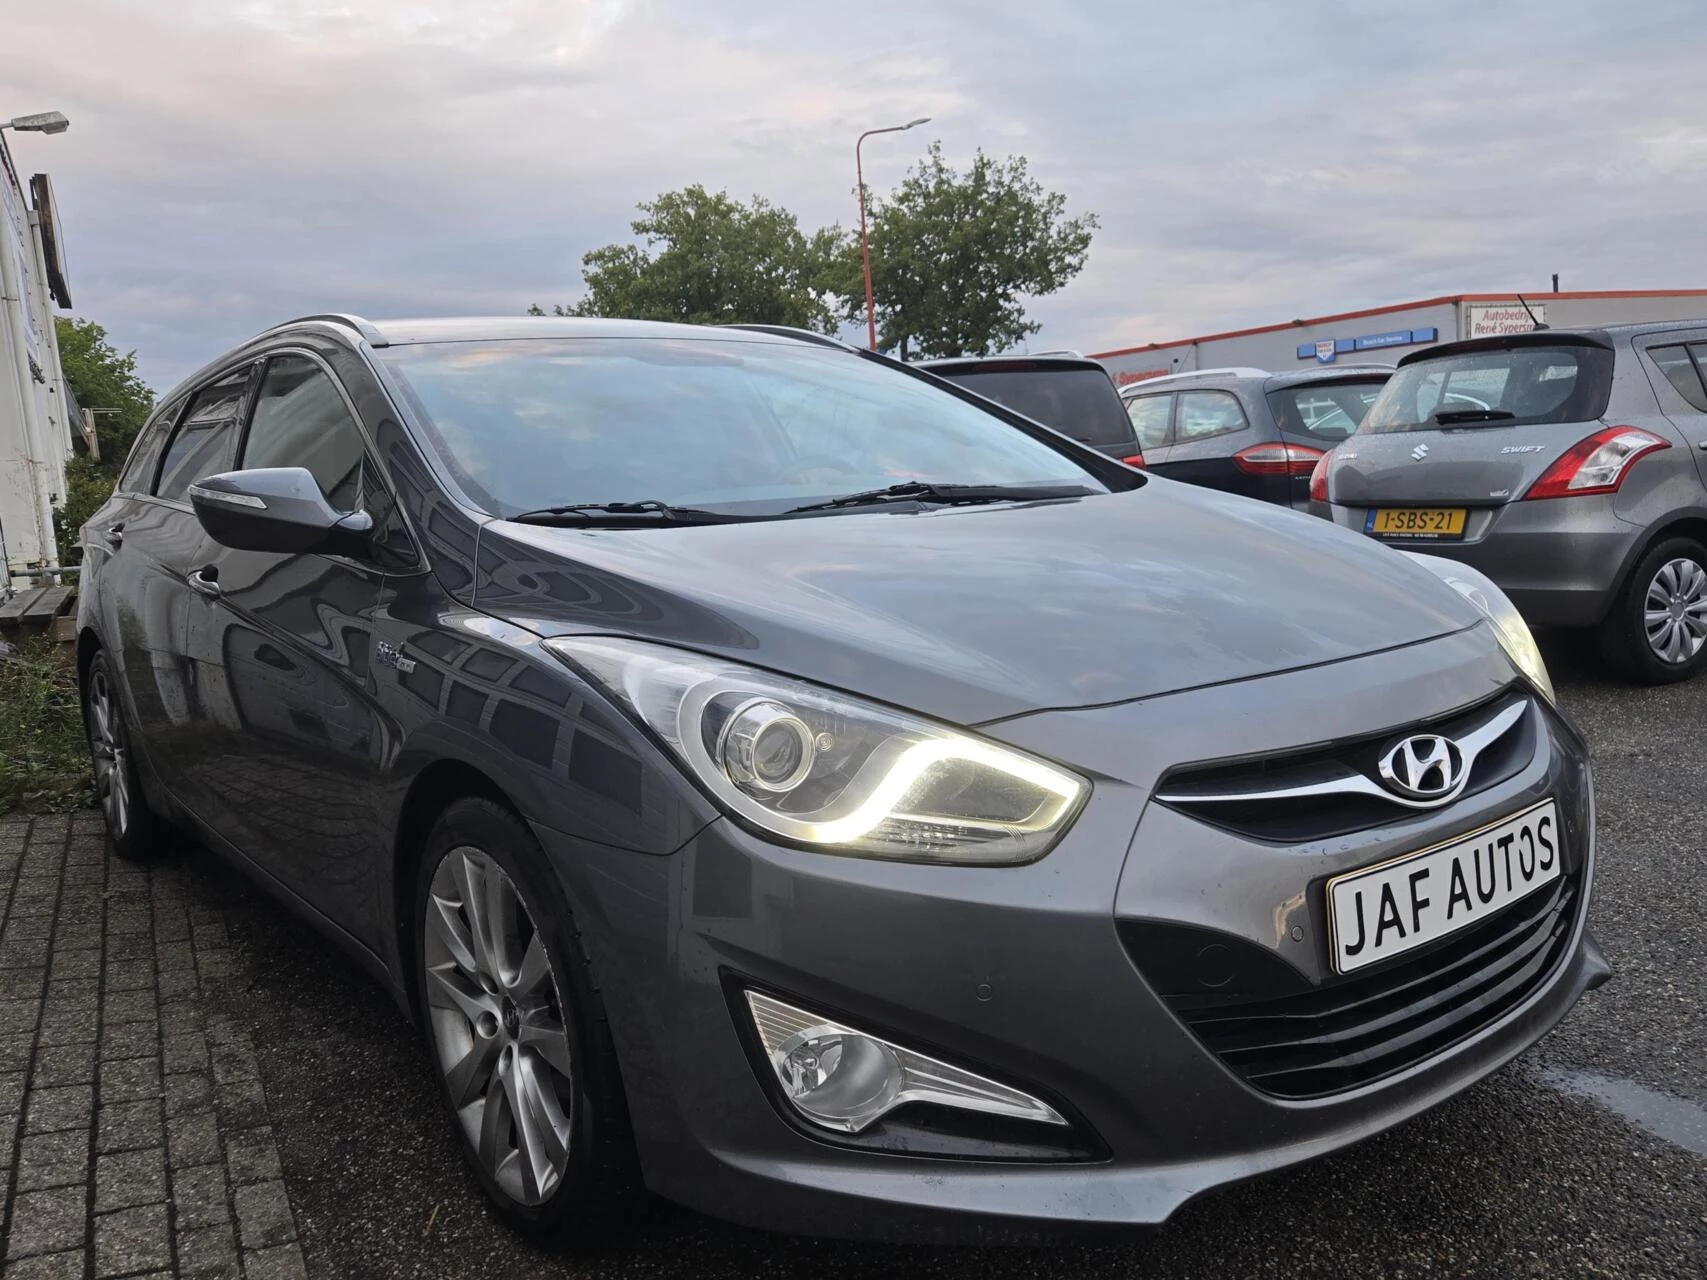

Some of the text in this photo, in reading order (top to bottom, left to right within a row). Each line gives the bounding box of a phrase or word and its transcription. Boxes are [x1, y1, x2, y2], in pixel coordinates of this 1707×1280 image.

[1500, 445, 1545, 454] SWIFT
[1383, 511, 1453, 529] 1-SBS-21
[1345, 815, 1554, 956] JAF AUTOS
